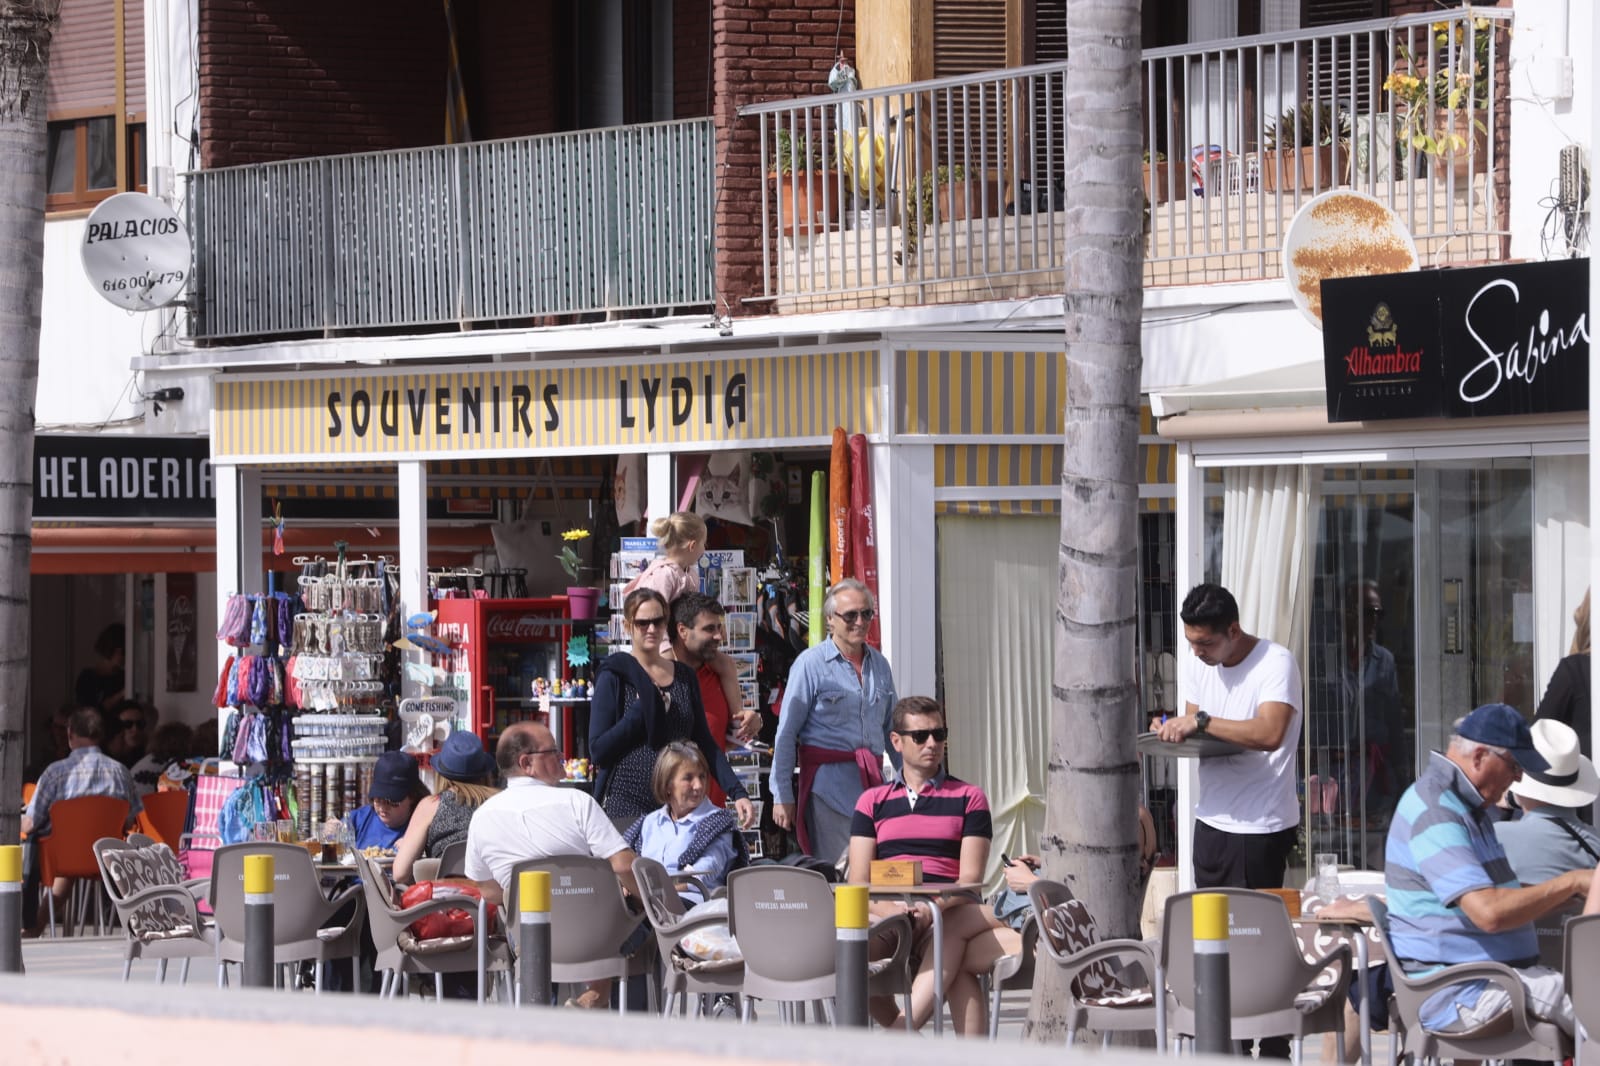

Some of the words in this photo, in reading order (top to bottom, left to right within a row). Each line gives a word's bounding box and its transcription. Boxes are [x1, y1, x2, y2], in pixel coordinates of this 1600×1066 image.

[87, 217, 178, 244] PALACIOS
[1459, 278, 1591, 402] Sabina
[1343, 344, 1421, 377] Alhambra
[328, 384, 560, 438] SOUVENIRS
[620, 372, 747, 433] LYDIA
[39, 456, 216, 499] HELADERIA
[405, 702, 425, 713] GONE
[425, 701, 455, 713] FISHING
